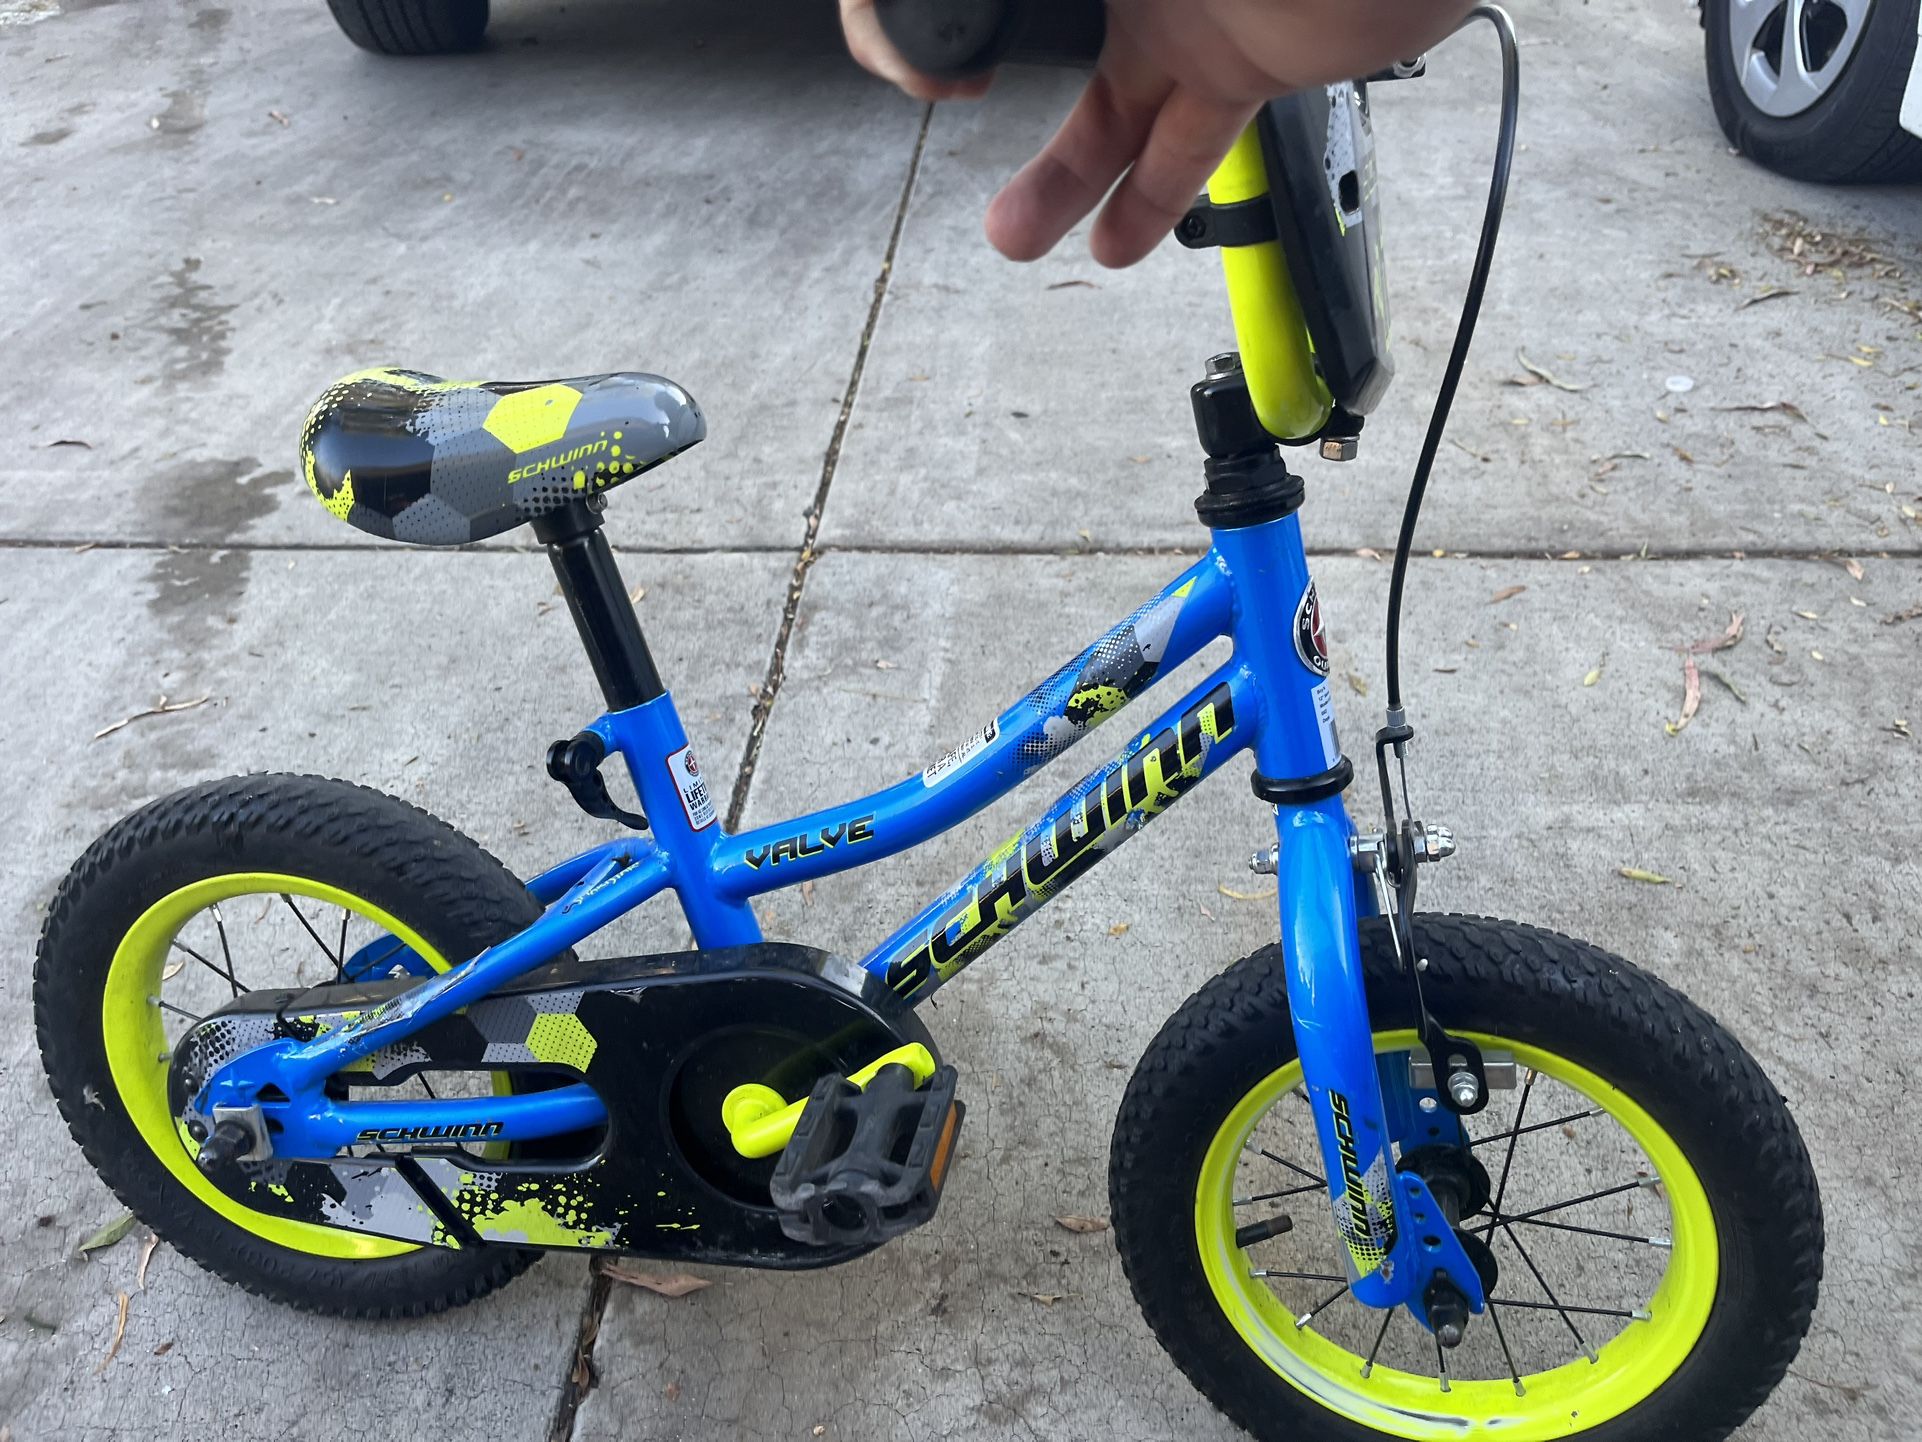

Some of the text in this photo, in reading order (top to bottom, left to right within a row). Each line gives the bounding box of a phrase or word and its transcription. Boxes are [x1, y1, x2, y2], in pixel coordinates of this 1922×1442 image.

[507, 440, 608, 484] SCHWINN
[743, 813, 876, 870] VALVE
[885, 681, 1236, 1000] SCHWINN
[356, 1121, 505, 1142] SCHWINN
[1328, 1088, 1372, 1239] SCHWINN
